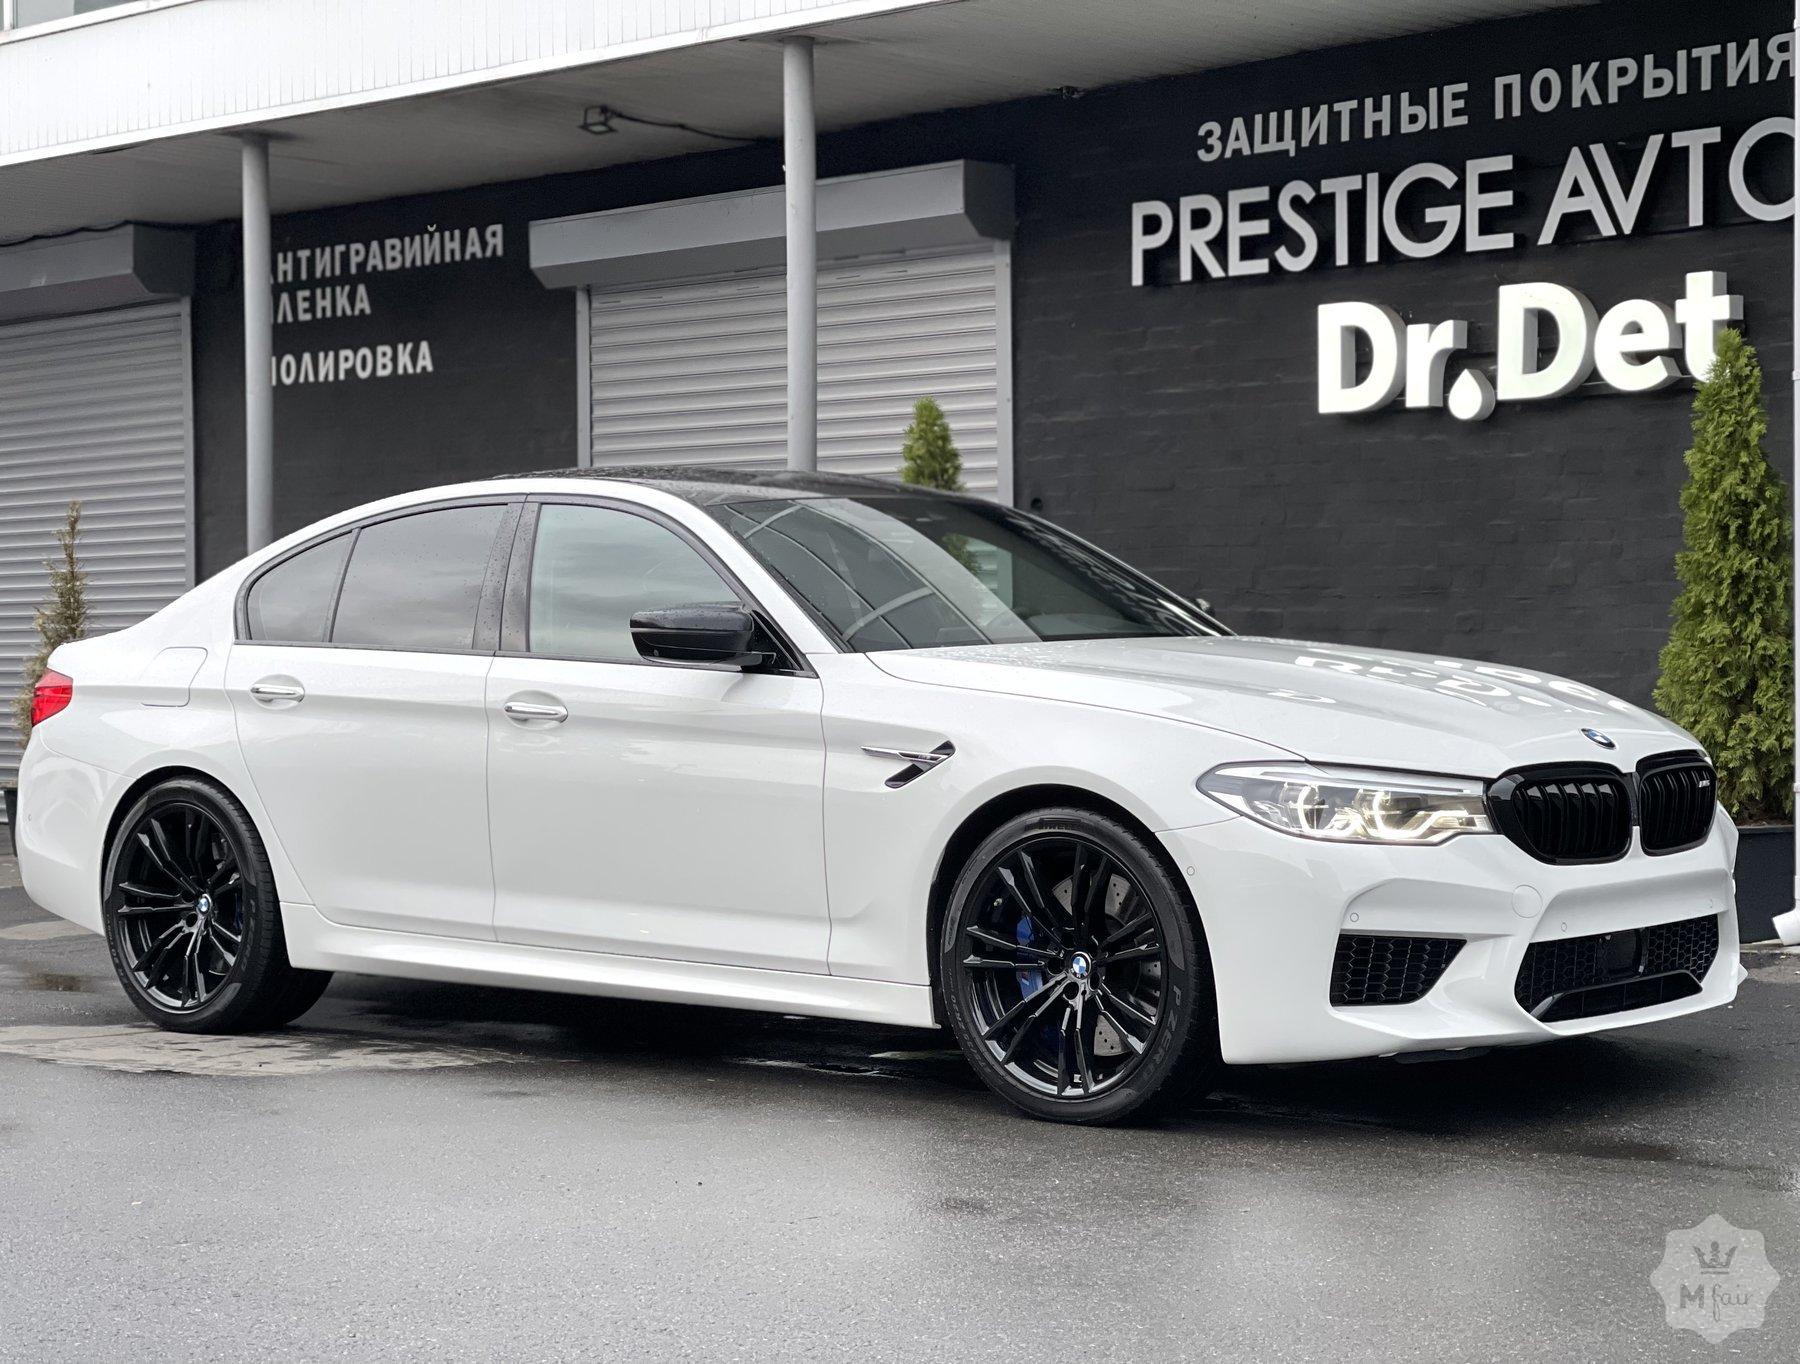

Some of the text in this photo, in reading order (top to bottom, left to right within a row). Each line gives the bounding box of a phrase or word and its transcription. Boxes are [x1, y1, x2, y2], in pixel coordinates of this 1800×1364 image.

[1197, 31, 1796, 162] ЗАЩИТНЫЕ ПОКРЫТИЯ
[270, 224, 504, 285] НТИГРАВИЙНАЯ
[1131, 154, 1514, 287] PRESTIGE
[271, 283, 371, 325] ЛЕНКА
